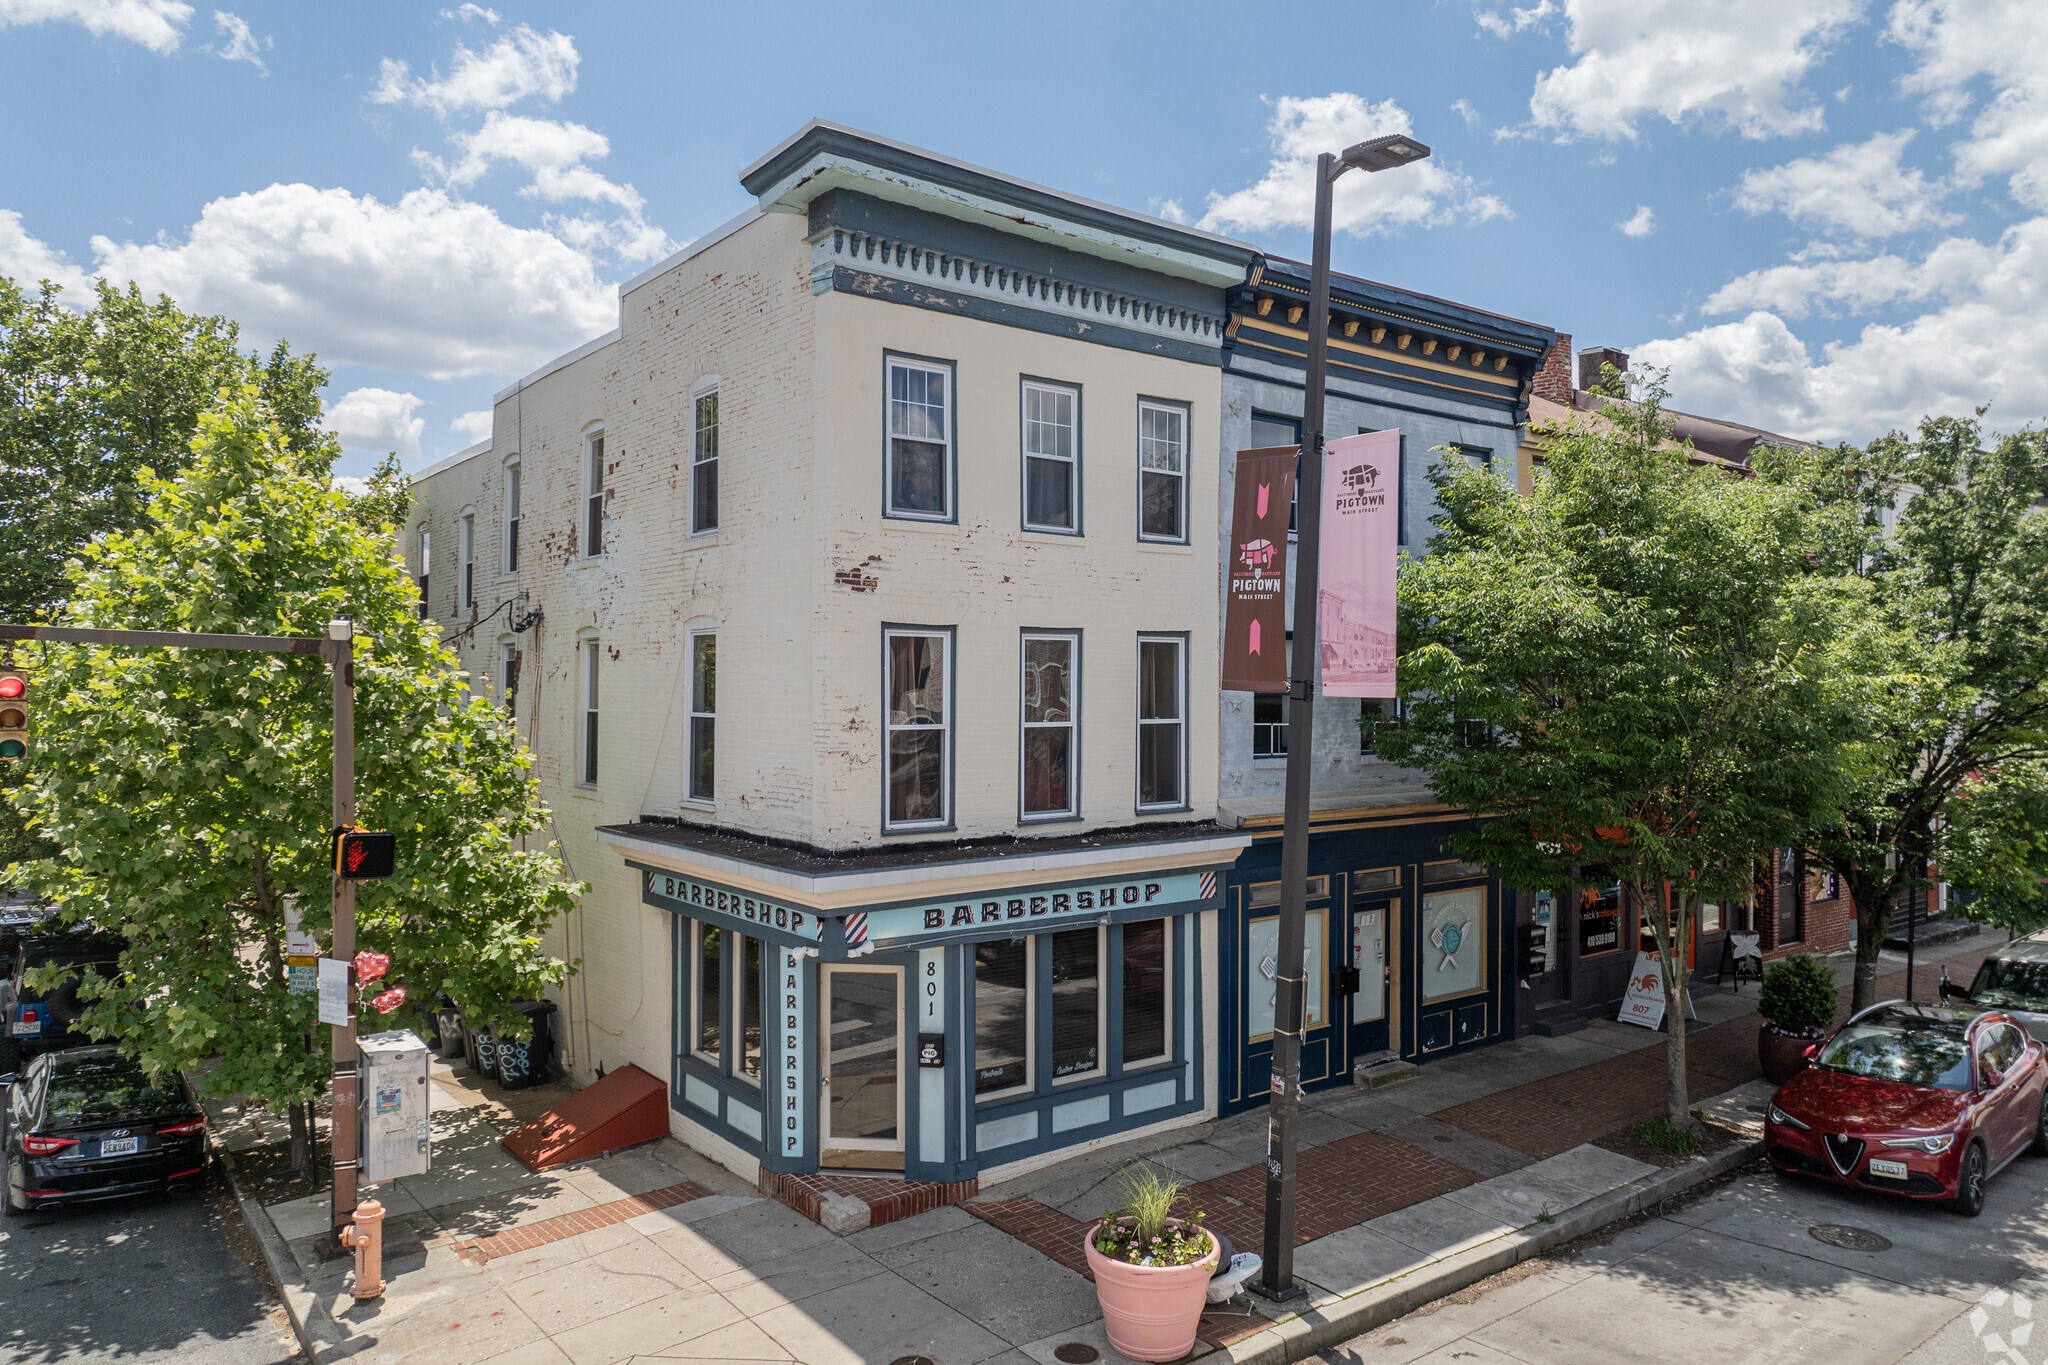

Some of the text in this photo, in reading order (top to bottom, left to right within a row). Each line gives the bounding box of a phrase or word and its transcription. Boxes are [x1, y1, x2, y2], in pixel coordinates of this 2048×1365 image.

[1336, 495, 1384, 510] PIGTOWN
[1232, 579, 1281, 592] PIGTOWN
[666, 877, 804, 932] BARBERSHOP
[923, 883, 1161, 929] BARBERSHOP
[1361, 914, 1375, 927] 803
[1587, 936, 1595, 947] 410
[1605, 932, 1615, 944] 9100
[927, 961, 936, 1017] 801
[1632, 1004, 1650, 1014] 807
[786, 954, 797, 1151] BARBERSHOP
[1074, 1061, 1094, 1071] Designs
